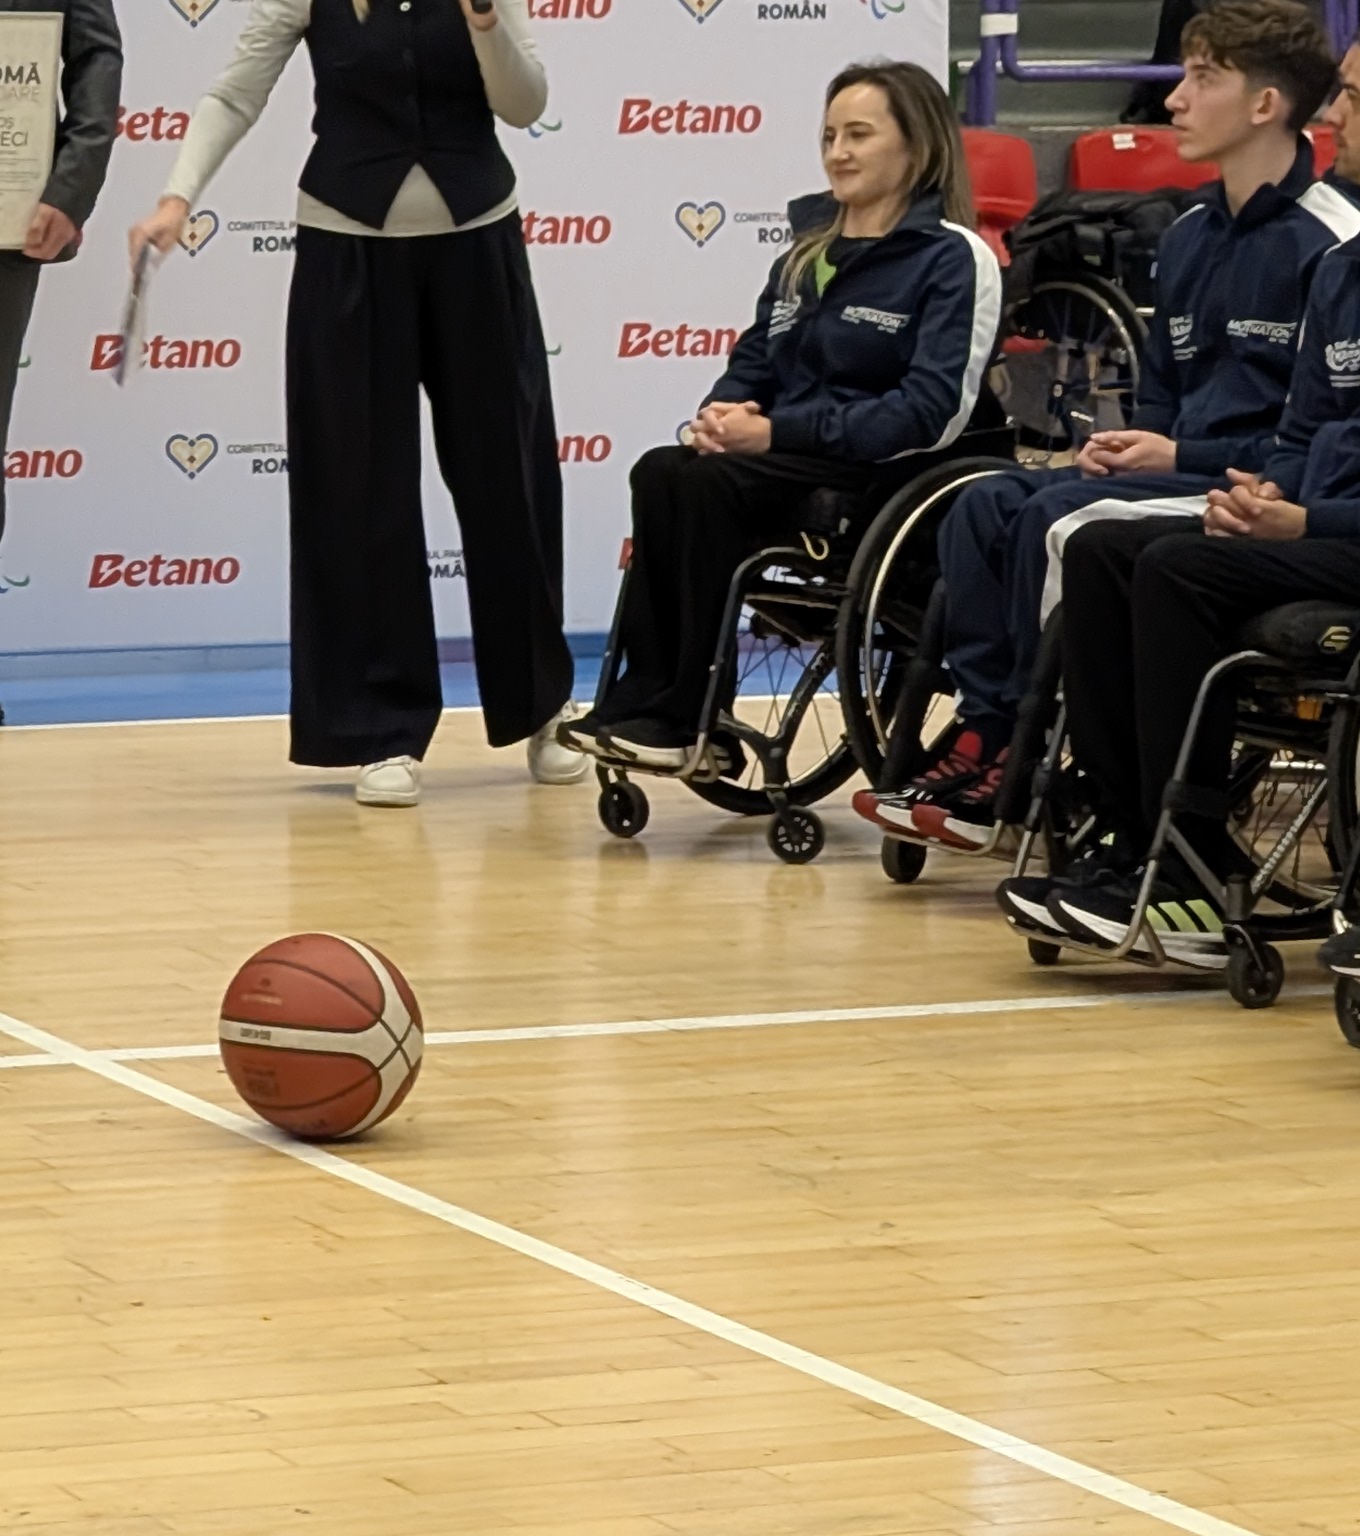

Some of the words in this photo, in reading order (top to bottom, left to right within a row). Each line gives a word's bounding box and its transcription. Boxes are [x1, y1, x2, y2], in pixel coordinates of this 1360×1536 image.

[758, 0, 826, 19] ROMÂN
[619, 99, 761, 134] Betano
[524, 211, 612, 244] tano
[89, 554, 240, 588] Betano
